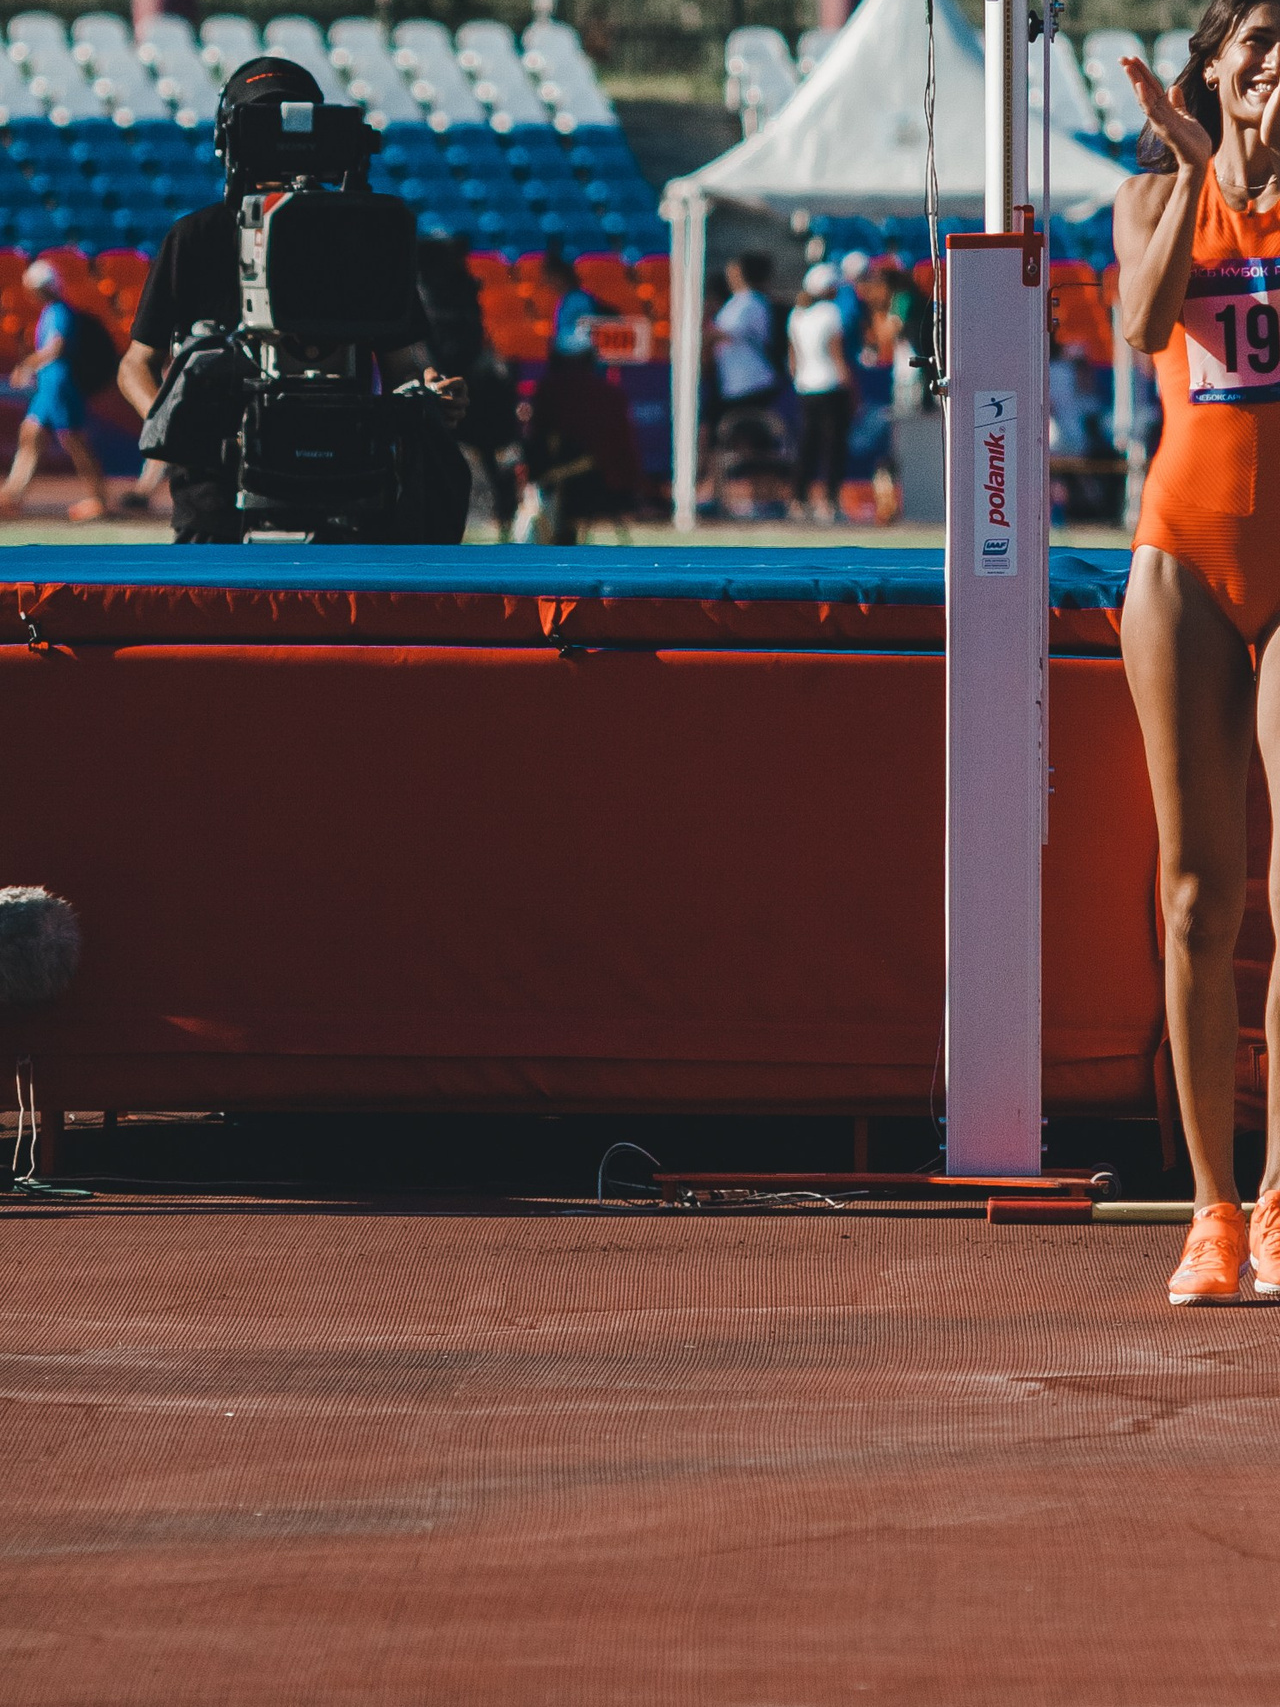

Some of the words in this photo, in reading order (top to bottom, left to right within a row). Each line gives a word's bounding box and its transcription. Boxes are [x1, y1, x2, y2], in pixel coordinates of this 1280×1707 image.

[1221, 266, 1268, 278] КУБОК
[983, 431, 1010, 528] polanik
[986, 541, 1007, 549] IAAF
